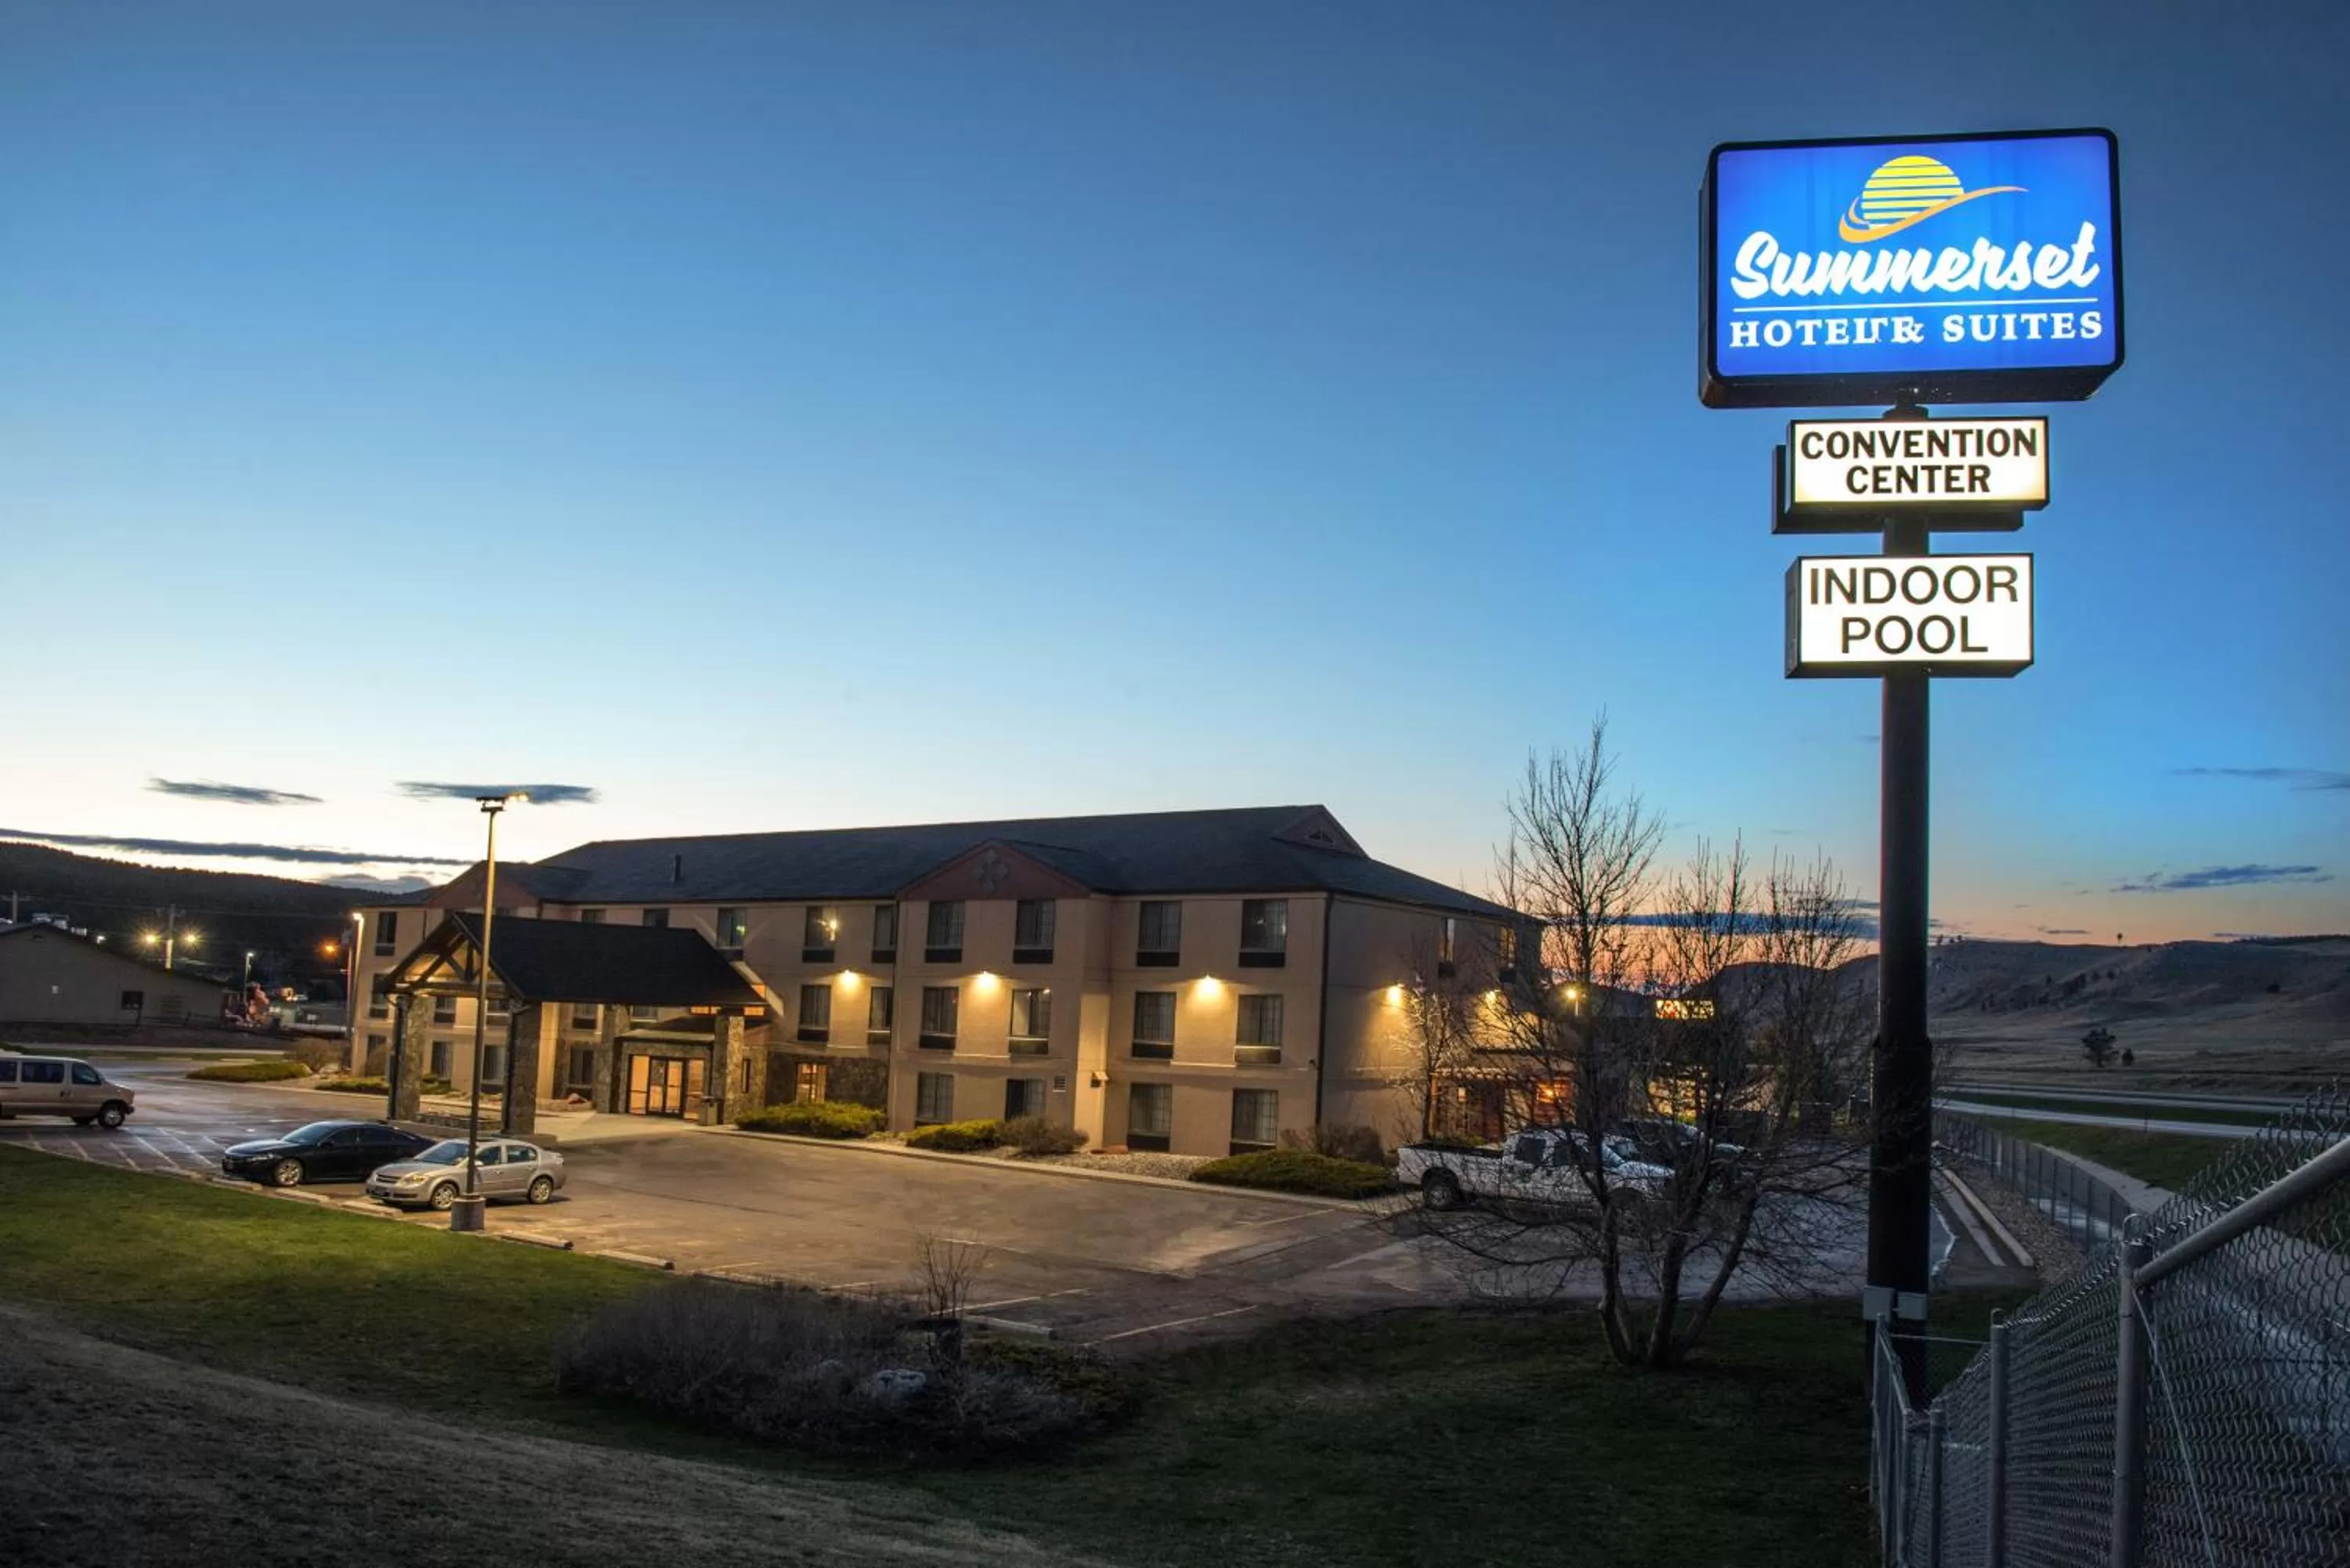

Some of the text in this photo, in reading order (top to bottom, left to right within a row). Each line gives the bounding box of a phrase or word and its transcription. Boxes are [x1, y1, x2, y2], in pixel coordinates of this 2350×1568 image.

[1730, 221, 2101, 299] Summerset
[1943, 311, 2102, 342] SUITES
[1801, 428, 2037, 460] CONVENTION
[1846, 464, 1991, 494] CENTER
[1810, 565, 2019, 605] INDOOR
[1842, 615, 1989, 655] POOL
